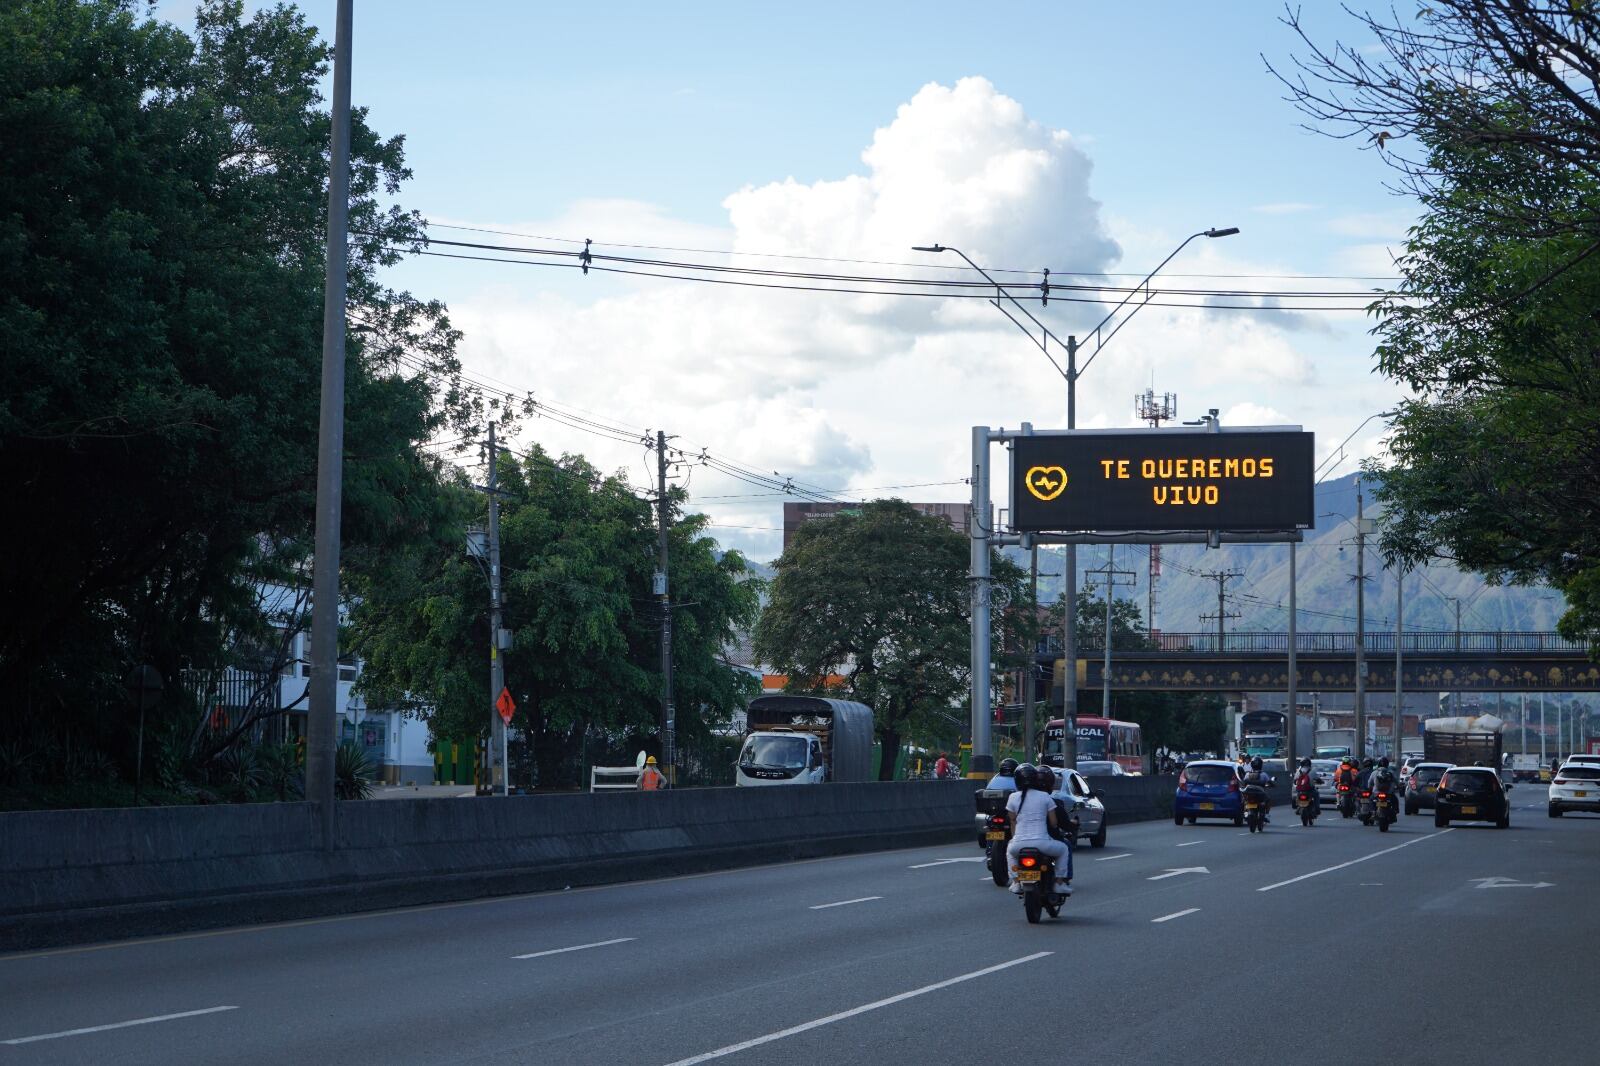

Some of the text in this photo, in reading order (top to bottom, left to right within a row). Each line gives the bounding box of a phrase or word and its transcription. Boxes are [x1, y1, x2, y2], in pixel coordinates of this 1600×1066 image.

[1100, 458, 1275, 479] TE QUEREMOS
[1153, 485, 1220, 505] VIVO
[1047, 727, 1105, 737] TRICAL
